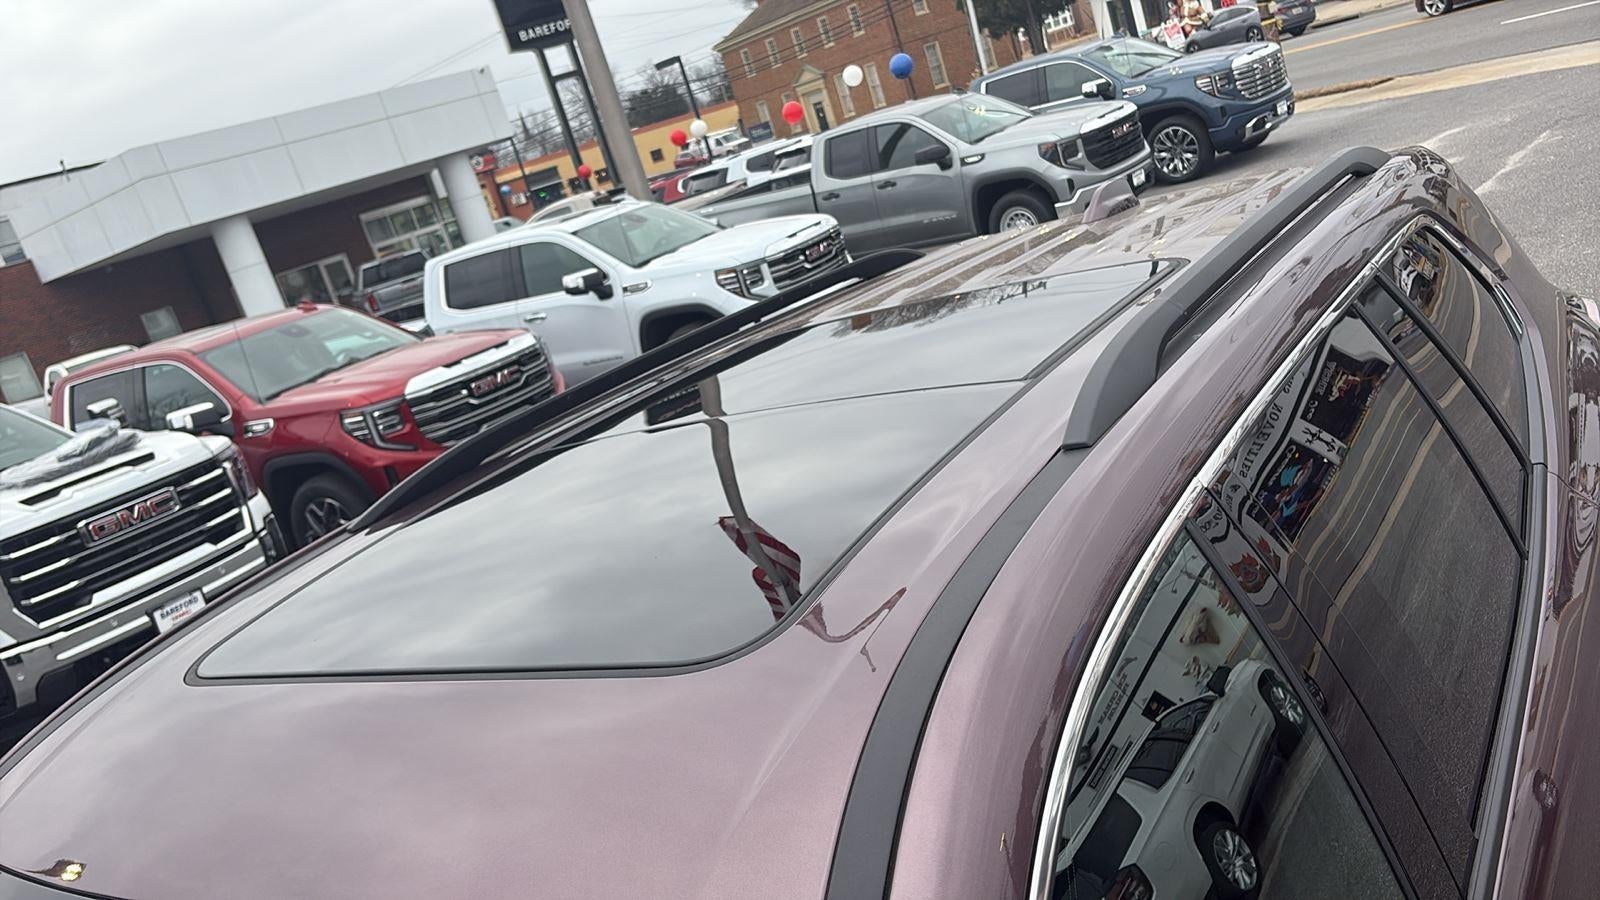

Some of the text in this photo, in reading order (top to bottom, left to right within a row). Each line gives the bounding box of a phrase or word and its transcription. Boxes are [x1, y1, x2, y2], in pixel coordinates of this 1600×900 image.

[518, 18, 571, 42] BAREFOR
[470, 365, 522, 396] GMC
[88, 491, 177, 540] GMC
